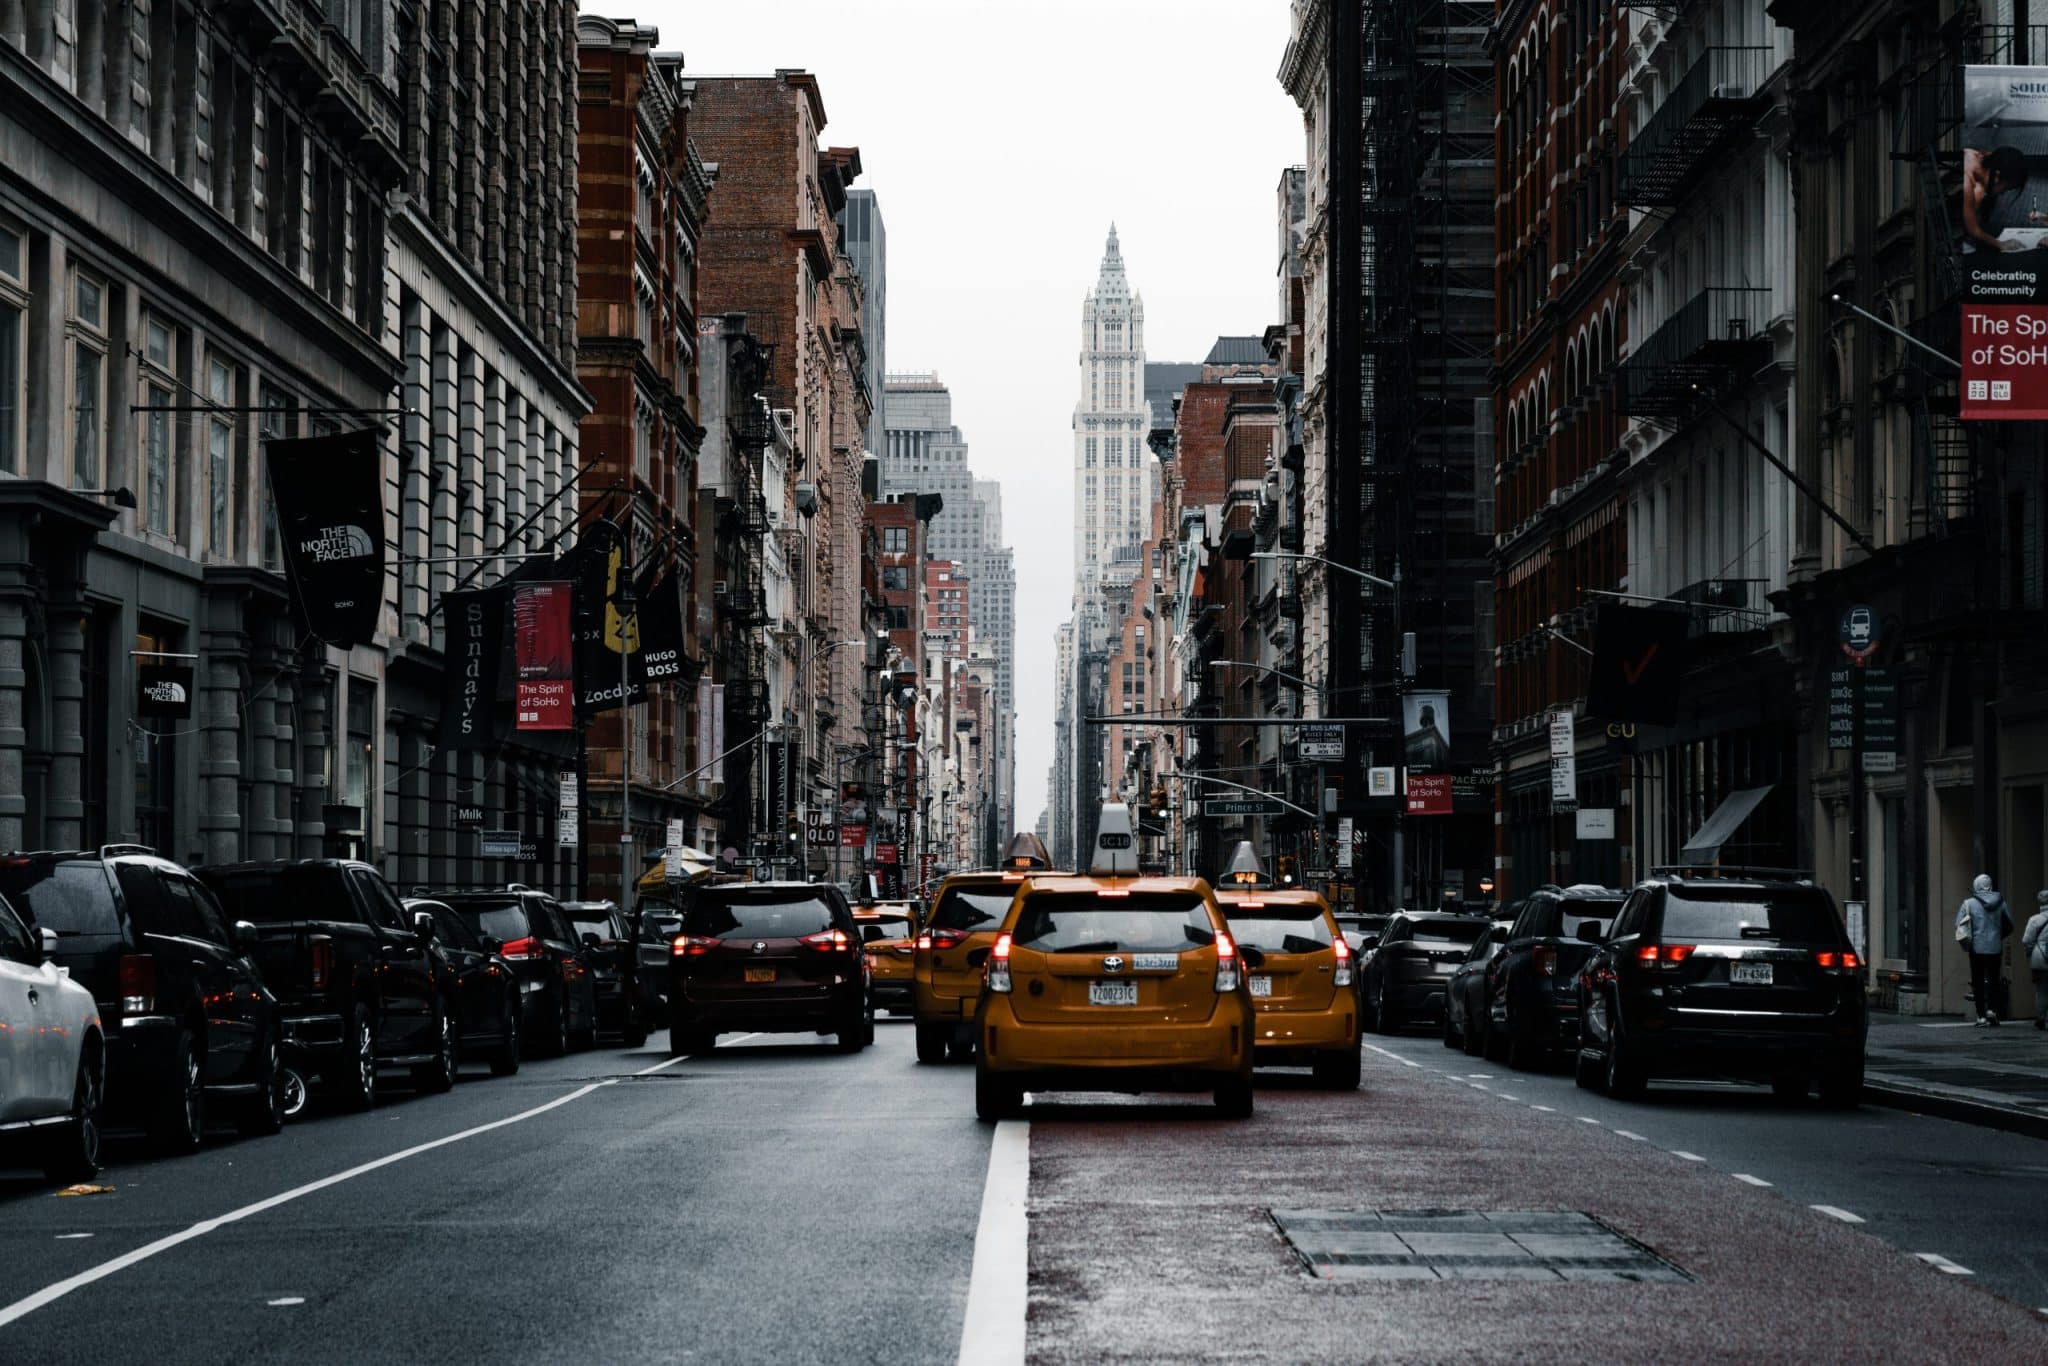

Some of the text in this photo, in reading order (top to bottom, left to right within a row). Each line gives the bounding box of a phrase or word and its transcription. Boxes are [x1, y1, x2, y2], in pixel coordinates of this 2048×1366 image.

[1971, 270, 2037, 283] Celebrating
[1971, 284, 2036, 297] Community
[1968, 314, 2048, 339] The Sp
[1971, 344, 1994, 365] of
[320, 526, 348, 540] THE
[300, 536, 349, 552] NORTH
[315, 548, 351, 563] FACE
[334, 600, 354, 608] SOHO
[645, 649, 677, 663] HUGO
[461, 603, 483, 734] Sundays
[646, 662, 680, 677] BOSS
[1831, 670, 1849, 683] SIM1
[144, 687, 172, 695] NORTH
[520, 684, 564, 696] The Spirit
[584, 682, 640, 704] Zocdoc
[1831, 687, 1853, 699] SIM3c
[151, 694, 172, 702] FACE
[521, 697, 560, 707] of SoHo
[1606, 722, 1636, 738] GU
[777, 747, 785, 798] BANANA
[1409, 777, 1445, 787] The Spirit
[1450, 775, 1477, 785] PACE
[1410, 789, 1419, 797] of
[1420, 788, 1442, 797] SoHo
[458, 808, 483, 820] Milk
[1225, 803, 1264, 813] Prince St
[776, 800, 785, 857] REPULIC
[808, 829, 835, 843] QLO
[520, 843, 537, 852] UGO
